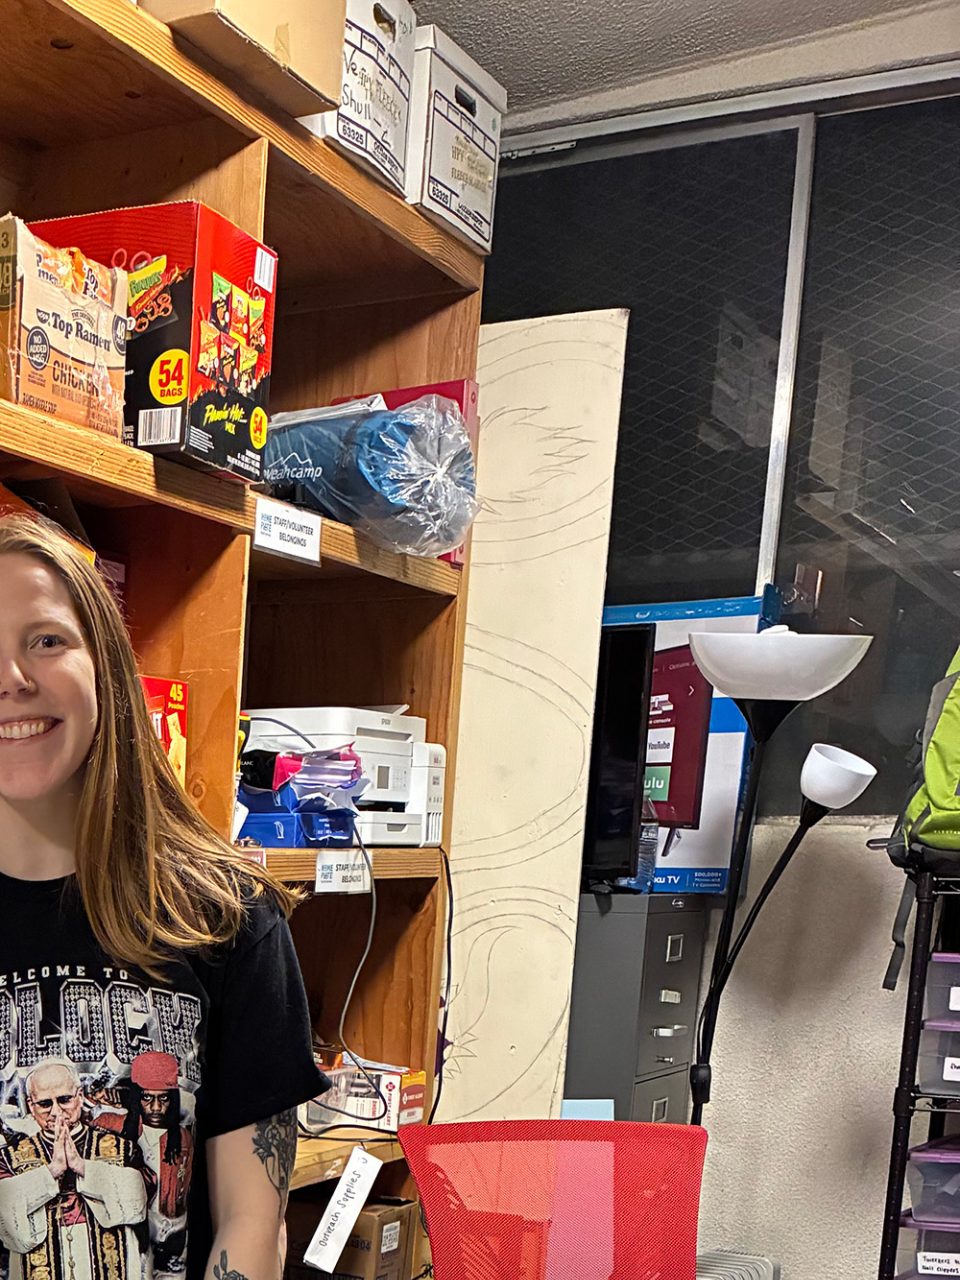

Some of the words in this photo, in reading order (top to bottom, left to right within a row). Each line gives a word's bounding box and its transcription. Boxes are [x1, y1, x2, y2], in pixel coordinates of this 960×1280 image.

[342, 124, 365, 145] 63325
[51, 312, 74, 339] Top
[74, 321, 111, 352] Ramen
[52, 360, 100, 398] CHICKEN
[158, 358, 184, 388] 54
[160, 388, 183, 398] BAGS
[253, 413, 263, 434] 54
[273, 516, 314, 537] STAFF/VOLUNTEER
[169, 683, 184, 702] 45
[648, 741, 671, 751] YouTube
[644, 776, 665, 789] ulu
[667, 876, 680, 884] TV
[103, 966, 130, 980] TO
[319, 1212, 341, 1248] Outreach
